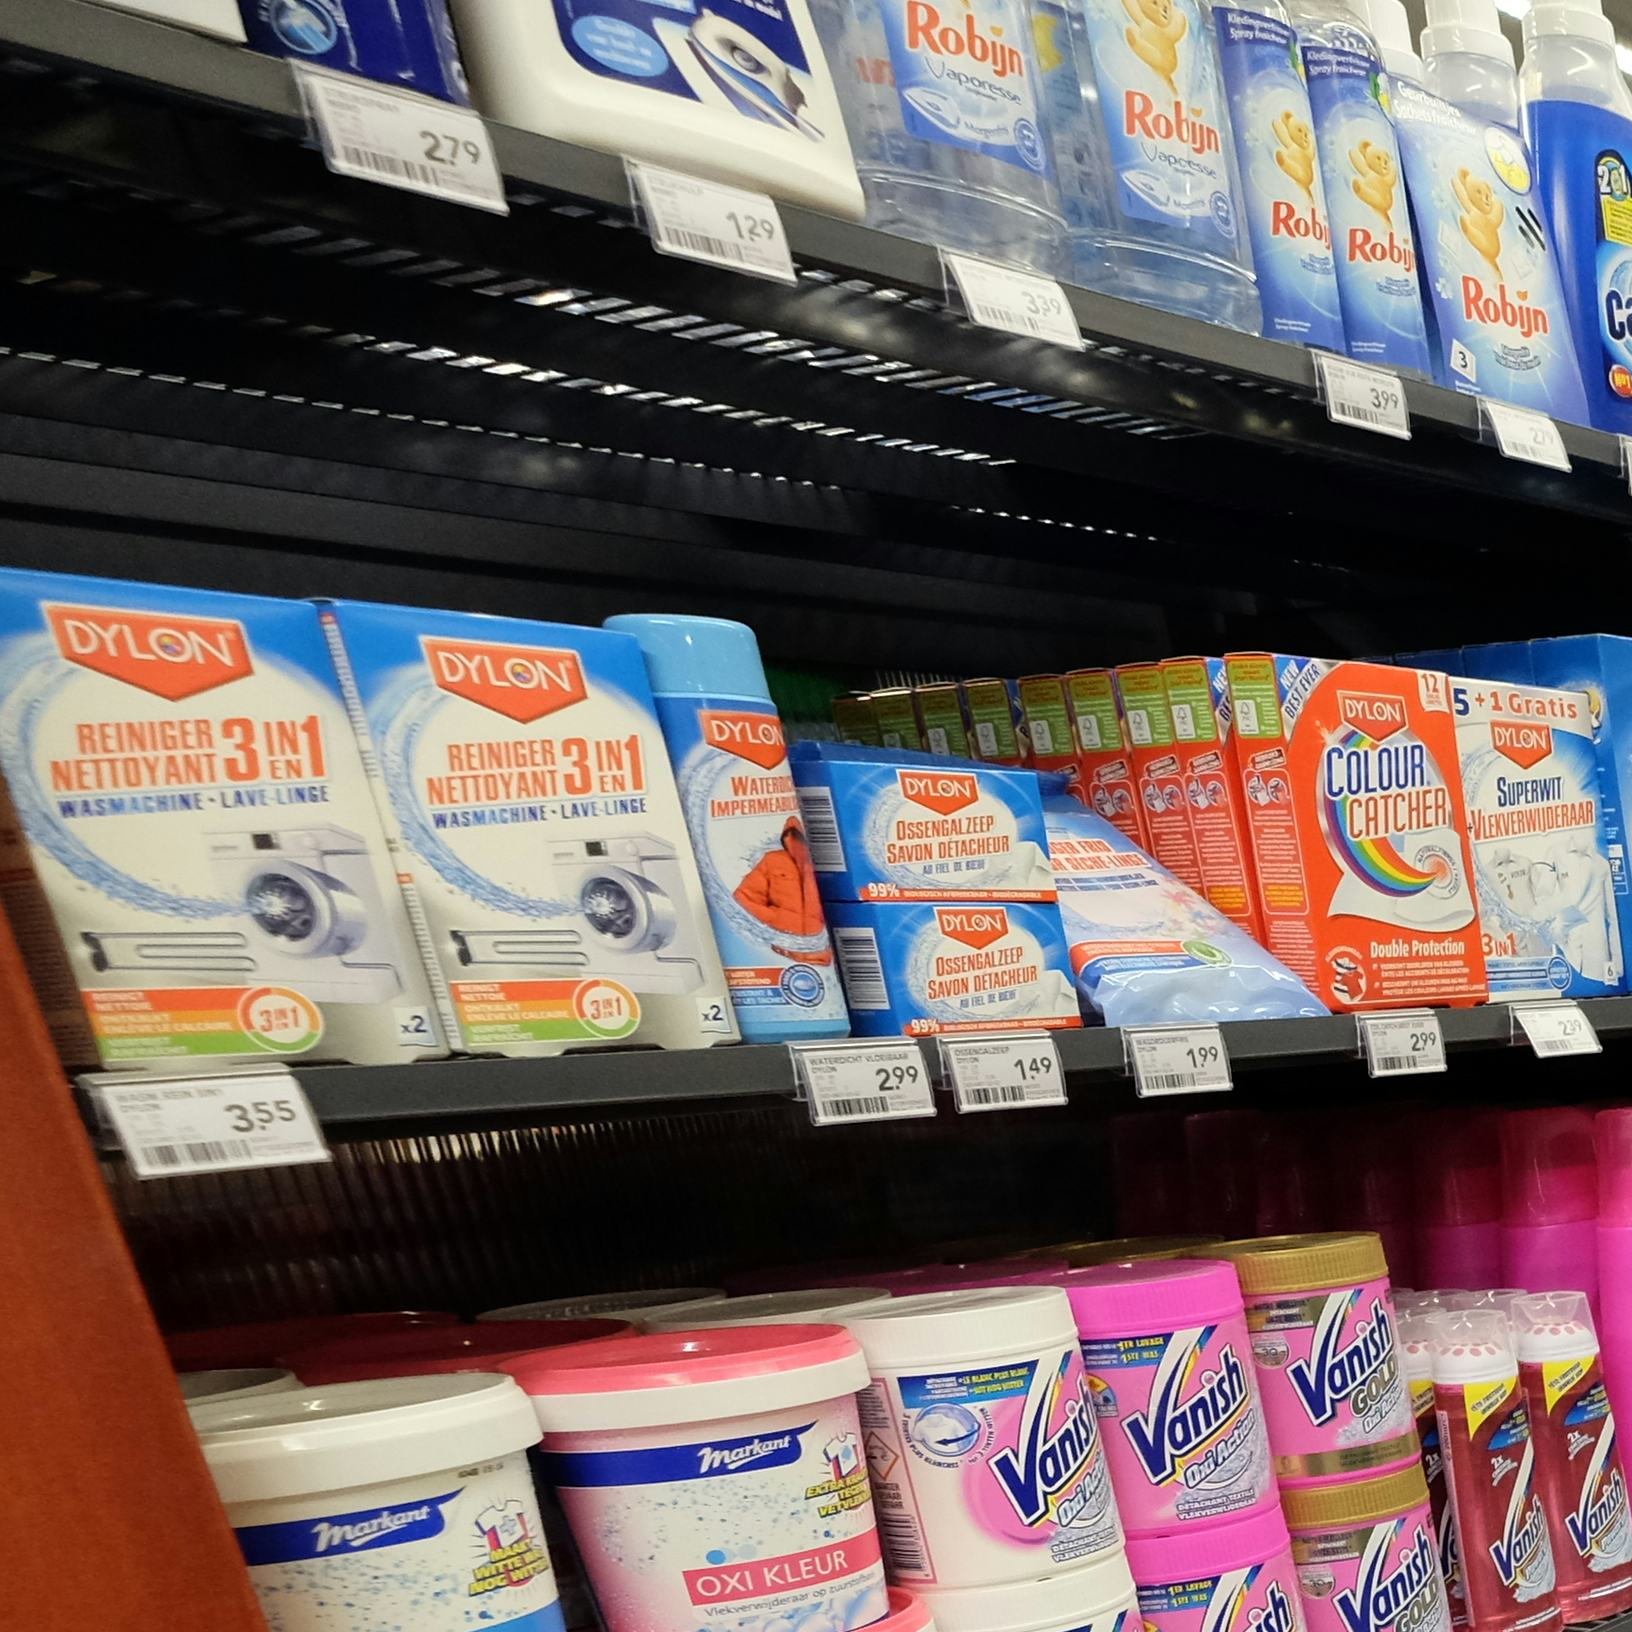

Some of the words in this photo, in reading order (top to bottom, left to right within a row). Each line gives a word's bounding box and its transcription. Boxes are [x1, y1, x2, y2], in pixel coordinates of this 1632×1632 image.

[907, 0, 1025, 78] Robijn
[1123, 89, 1221, 156] Robijn
[1461, 274, 1549, 338] Robijn
[1457, 350, 1469, 369] 3
[63, 617, 234, 667] DYLON
[436, 652, 571, 693] DYLON
[1420, 674, 1440, 692] 12
[1345, 699, 1402, 725] DYLON
[1508, 692, 1578, 720] Gratis
[76, 718, 214, 756] REINIGER
[223, 718, 261, 783] 3
[301, 714, 325, 779] 1
[1495, 727, 1547, 748] DYLON
[50, 753, 216, 793] NETTOYANT
[447, 739, 556, 774] REINIGER
[561, 736, 594, 798] 3
[625, 733, 644, 792] 1
[1326, 742, 1426, 799] COLOUR
[59, 790, 205, 819] WASMACHINE
[220, 784, 330, 809] LAVE-LINGE
[426, 771, 560, 805] NETTOYANT
[903, 777, 970, 798] DYLON
[1497, 776, 1561, 805] SUPERWIT
[432, 803, 549, 829] WASMACHINE
[561, 798, 647, 821] LAVE-LINGE
[896, 816, 994, 841] OSSENGALZEEP
[1348, 786, 1448, 840] CATCHER
[887, 842, 934, 864] SAVON
[938, 832, 1009, 860] DÉTACHEUR
[868, 883, 900, 898] 99%
[941, 914, 1000, 933] DYLON
[936, 947, 1023, 976] OSSENGALZEEP
[1369, 938, 1417, 958] Double
[1418, 937, 1465, 959] Protection
[928, 980, 970, 1000] SAVON
[974, 966, 1037, 995] DÉTACHEUR
[401, 1014, 427, 1034] x2
[702, 1003, 724, 1023] x2
[1013, 1056, 1052, 1081] 1.49
[1185, 1044, 1219, 1069] 1.99
[875, 1065, 918, 1092] 2.99
[1290, 1300, 1391, 1427] Vanish
[1122, 1342, 1249, 1486] Vanish
[697, 1436, 792, 1472] Markant
[311, 1502, 431, 1552] Markant
[696, 1571, 752, 1597] OXI
[763, 1549, 849, 1585] KLEUR
